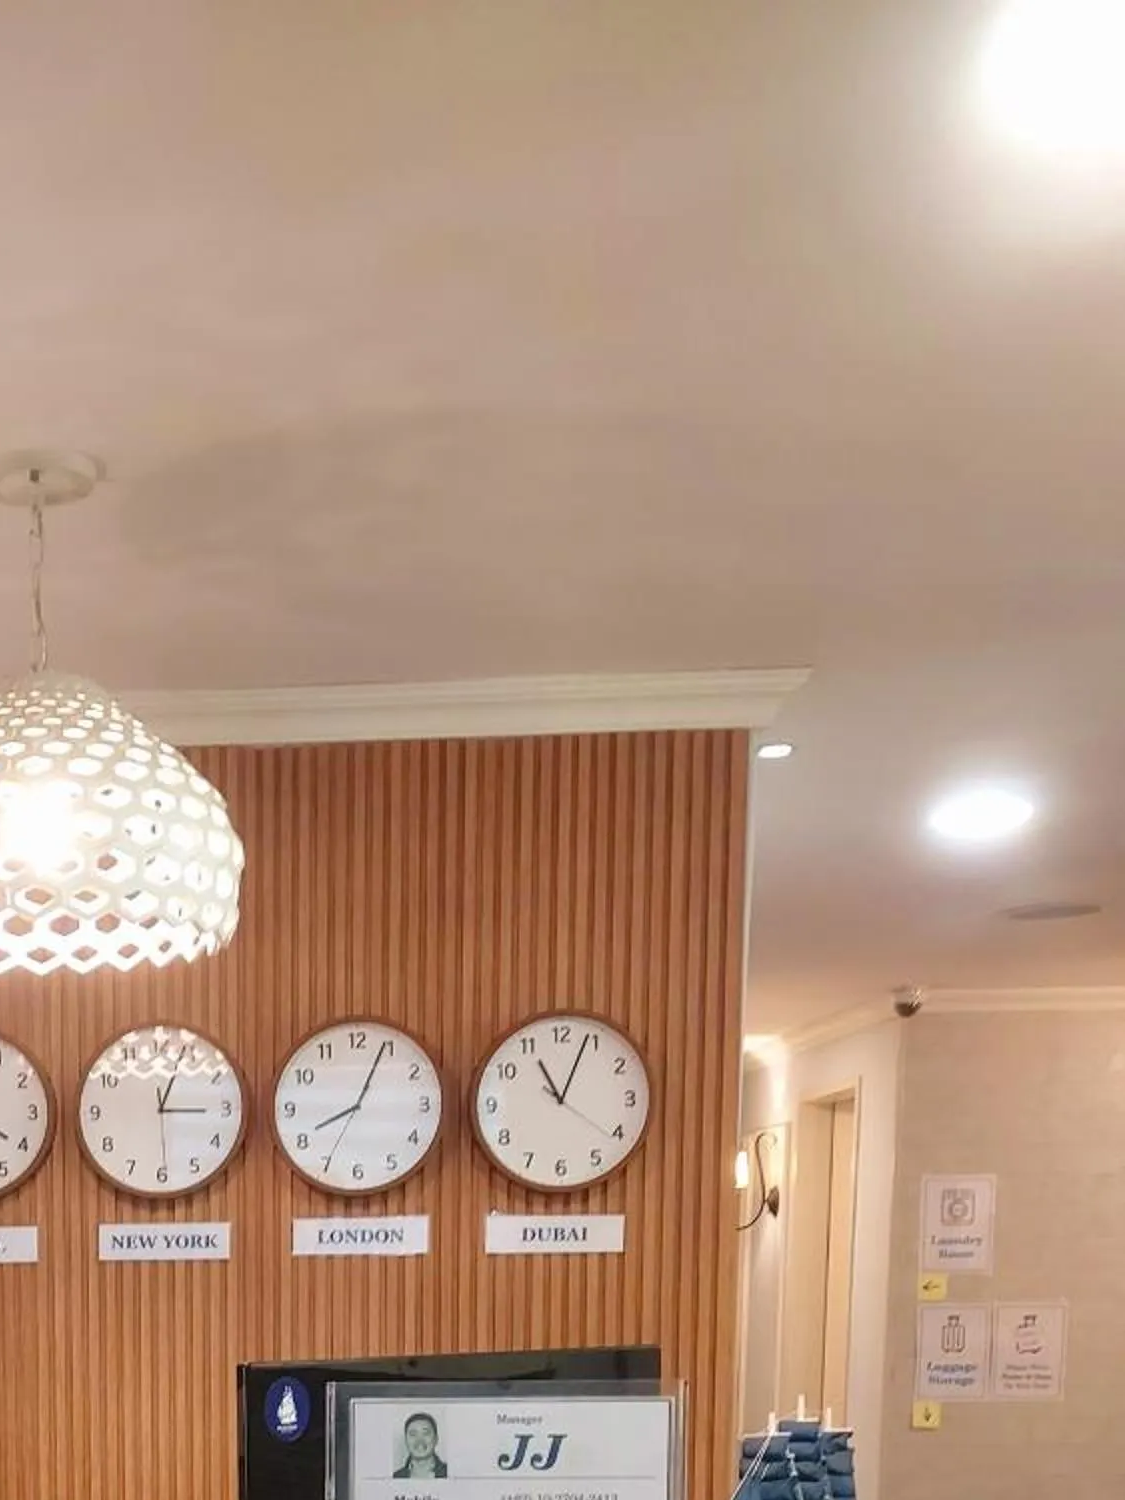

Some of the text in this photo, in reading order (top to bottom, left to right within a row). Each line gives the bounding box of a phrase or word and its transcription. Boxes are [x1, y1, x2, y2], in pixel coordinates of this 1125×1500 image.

[349, 1032, 366, 1048] 12
[553, 1027, 571, 1043] 12
[593, 1035, 599, 1050] 1
[317, 1044, 333, 1059] 11
[387, 1041, 394, 1056] 1
[520, 1038, 535, 1054] 11
[409, 1064, 420, 1079] 2
[497, 1063, 516, 1079] 10
[614, 1059, 626, 1074] 2
[17, 1073, 28, 1089] 2
[296, 1069, 314, 1085] 10
[419, 1097, 430, 1112] 3
[486, 1098, 497, 1113] 9
[625, 1090, 636, 1106] 3
[28, 1105, 38, 1120] 3
[90, 1105, 101, 1120] 9
[221, 1102, 231, 1118] 3
[284, 1102, 296, 1118] 9
[407, 1129, 419, 1144] 4
[498, 1130, 510, 1145] 8
[612, 1124, 624, 1139] 4
[17, 1137, 29, 1152] 4
[103, 1138, 114, 1152] 8
[209, 1134, 221, 1148] 4
[297, 1134, 308, 1149] 8
[189, 1158, 200, 1173] 5
[386, 1154, 397, 1170] 5
[523, 1152, 534, 1168] 7
[590, 1150, 602, 1166] 5
[126, 1160, 136, 1175] 7
[353, 1164, 364, 1180] 6
[555, 1160, 567, 1175] 6
[156, 1168, 168, 1183] 6
[111, 1235, 219, 1249] NEW YORK
[317, 1229, 404, 1244] LONDON
[522, 1228, 587, 1242] DUBAI
[497, 1414, 543, 1425] Manager
[498, 1434, 568, 1471] JJ
